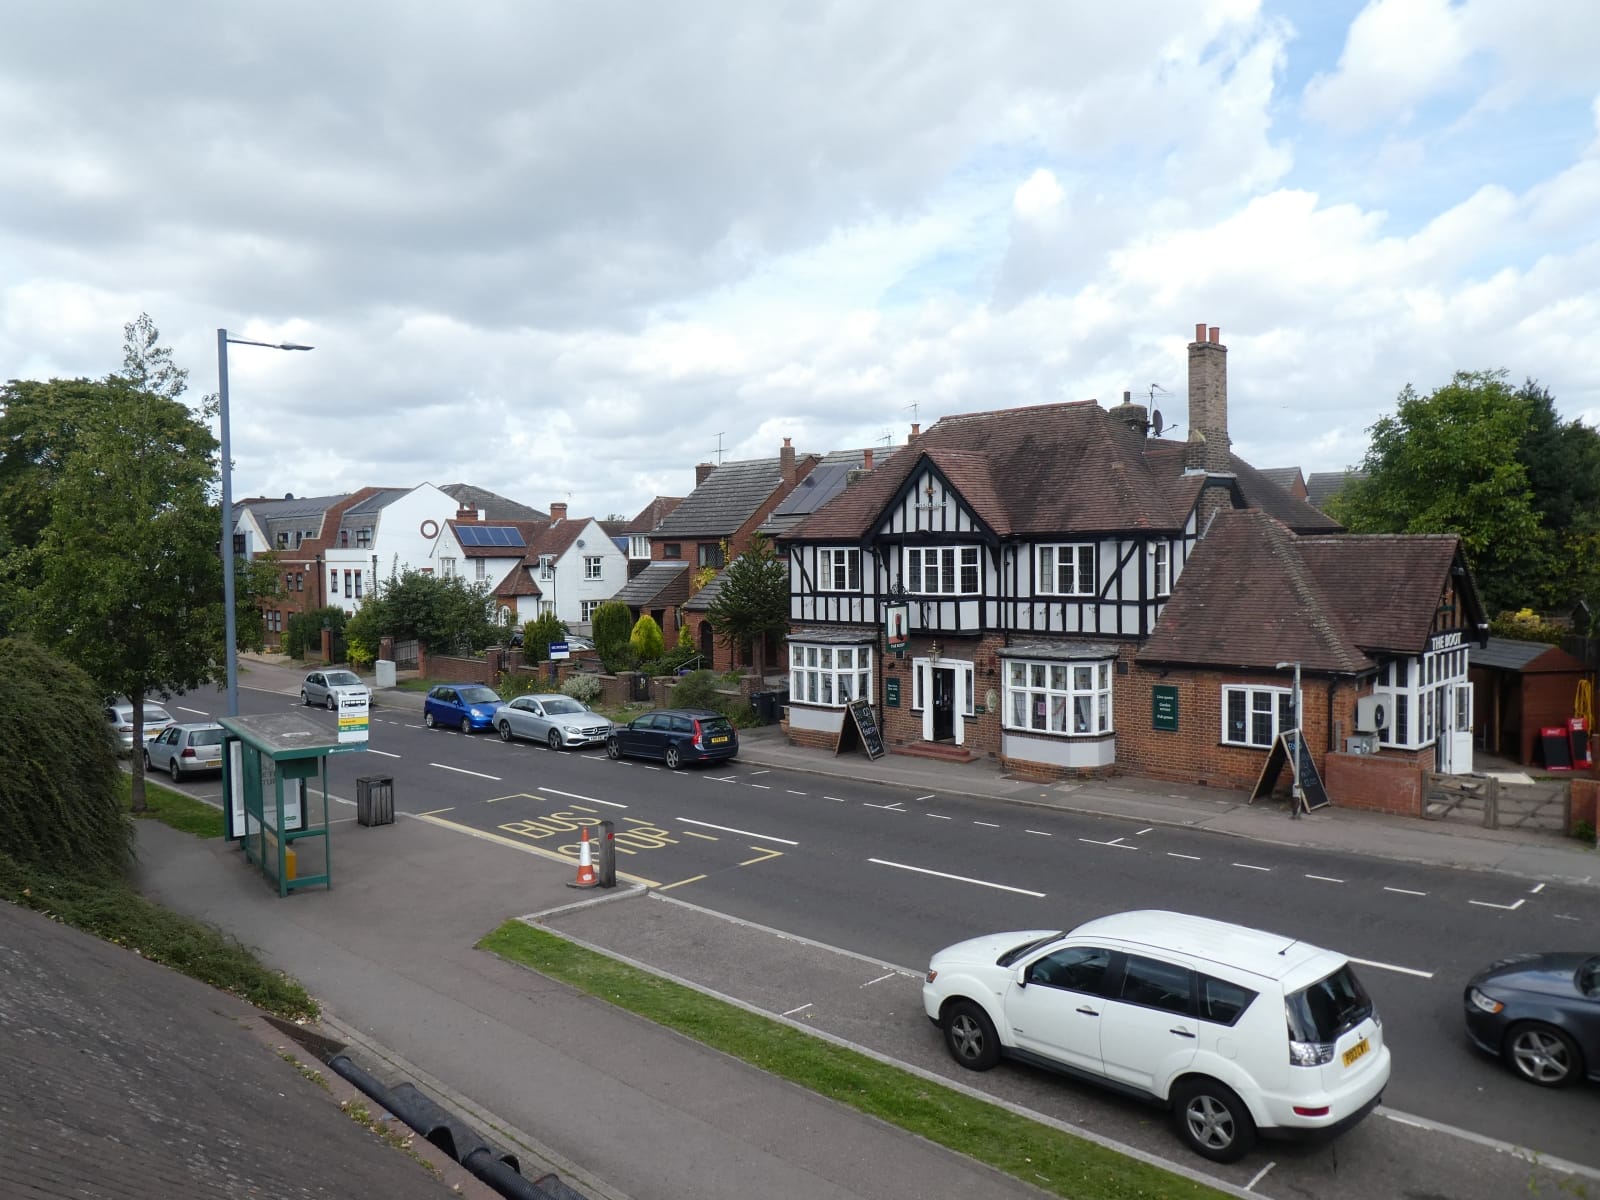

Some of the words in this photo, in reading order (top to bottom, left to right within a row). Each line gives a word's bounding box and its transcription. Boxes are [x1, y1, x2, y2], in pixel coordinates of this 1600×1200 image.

[1432, 635, 1444, 650] THE
[1445, 632, 1462, 647] BOOT
[498, 811, 601, 839] BUS
